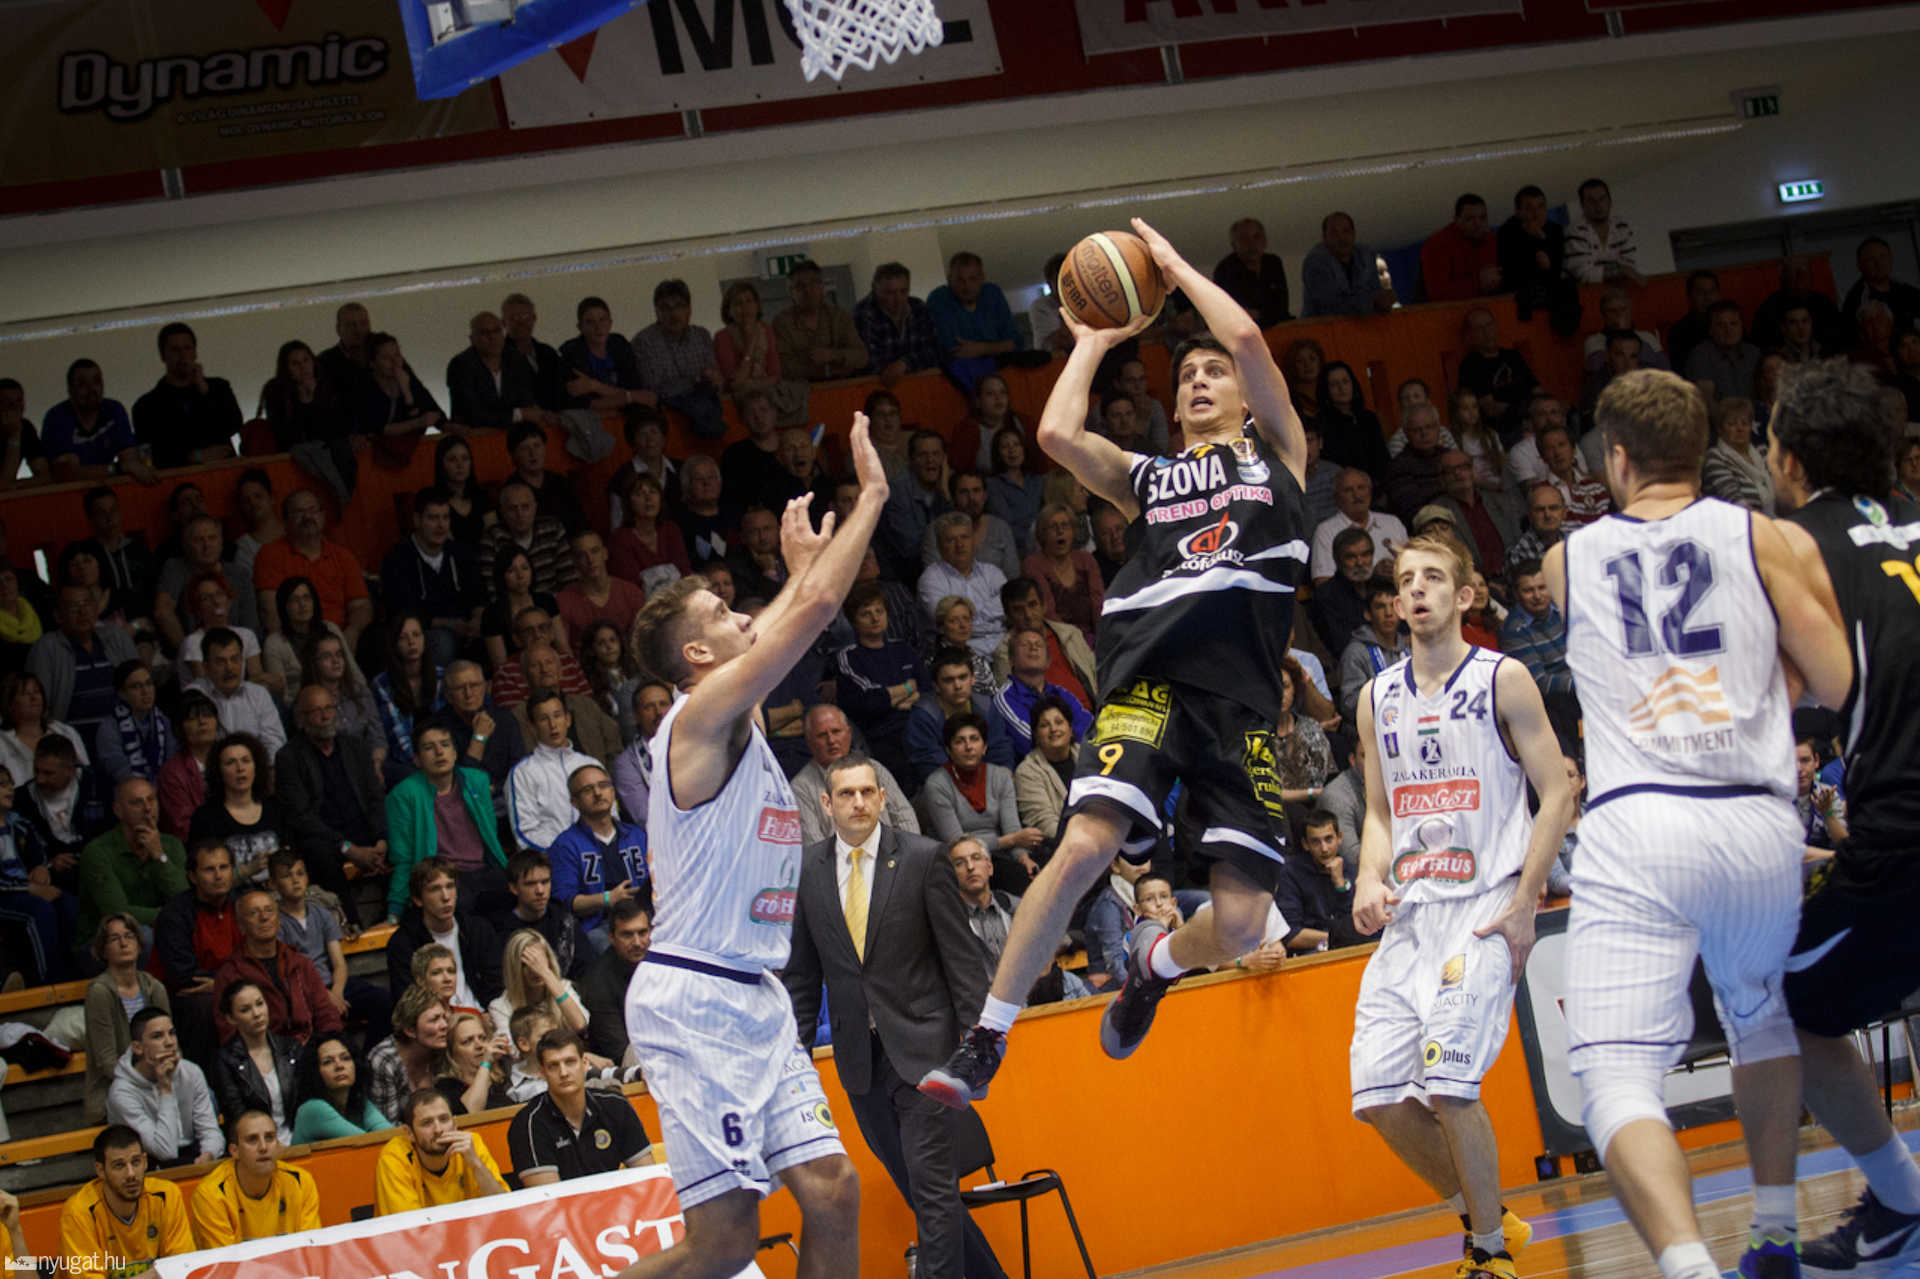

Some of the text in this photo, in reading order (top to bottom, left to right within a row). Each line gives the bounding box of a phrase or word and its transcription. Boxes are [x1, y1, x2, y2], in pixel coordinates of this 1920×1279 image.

[60, 34, 388, 118] Dynamic
[1081, 244, 1119, 305] molten
[1145, 484, 1273, 525] TREND OPTIKA
[1601, 536, 1727, 660] 12
[1450, 689, 1488, 720] 24
[1098, 743, 1124, 776] 9
[721, 1112, 744, 1148] 6
